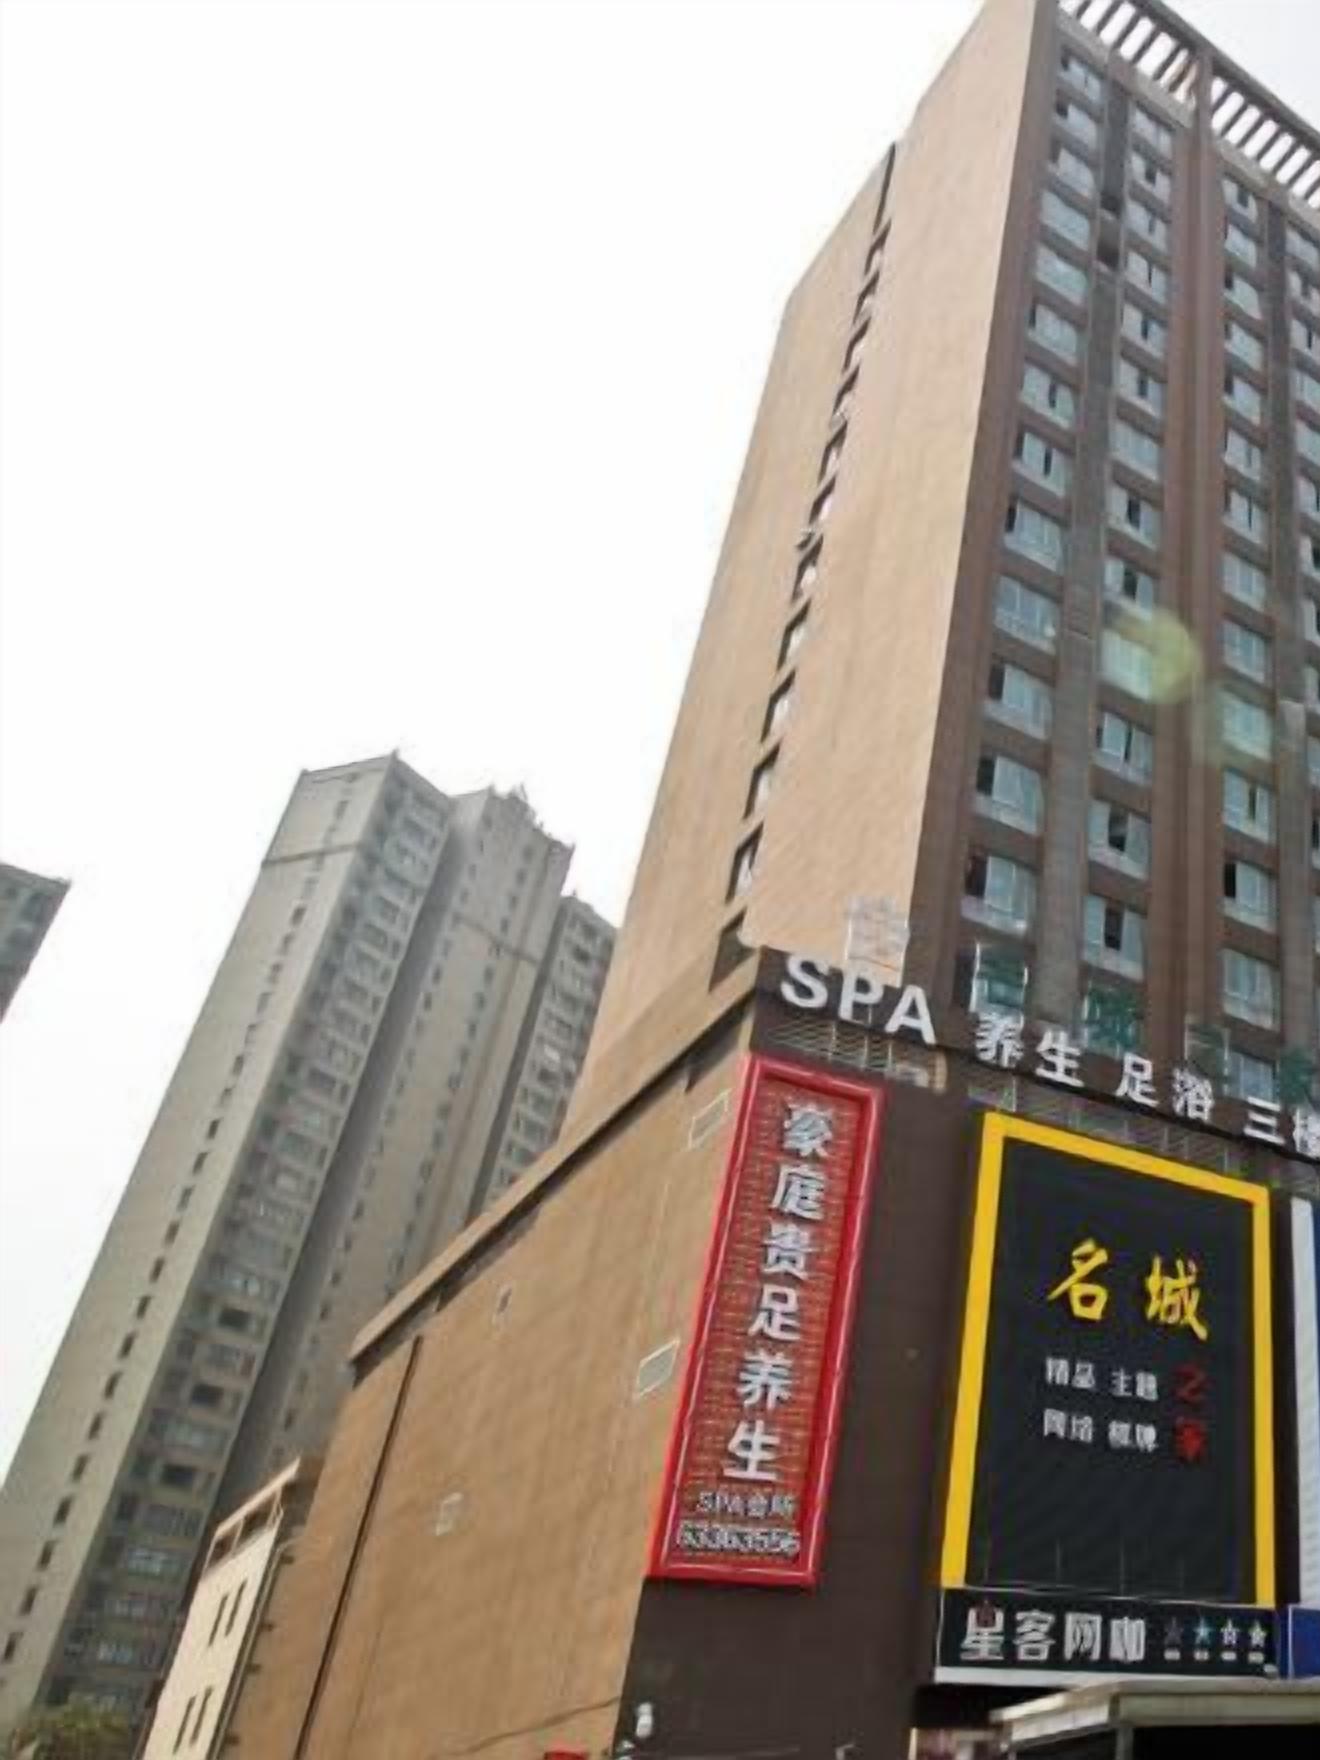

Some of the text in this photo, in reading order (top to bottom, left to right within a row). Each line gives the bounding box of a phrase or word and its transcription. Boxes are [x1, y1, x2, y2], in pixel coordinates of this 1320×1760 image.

[780, 952, 937, 1046] SPA
[1049, 1238, 1208, 1341] 名城
[960, 1600, 1147, 1663] 星客网咖
